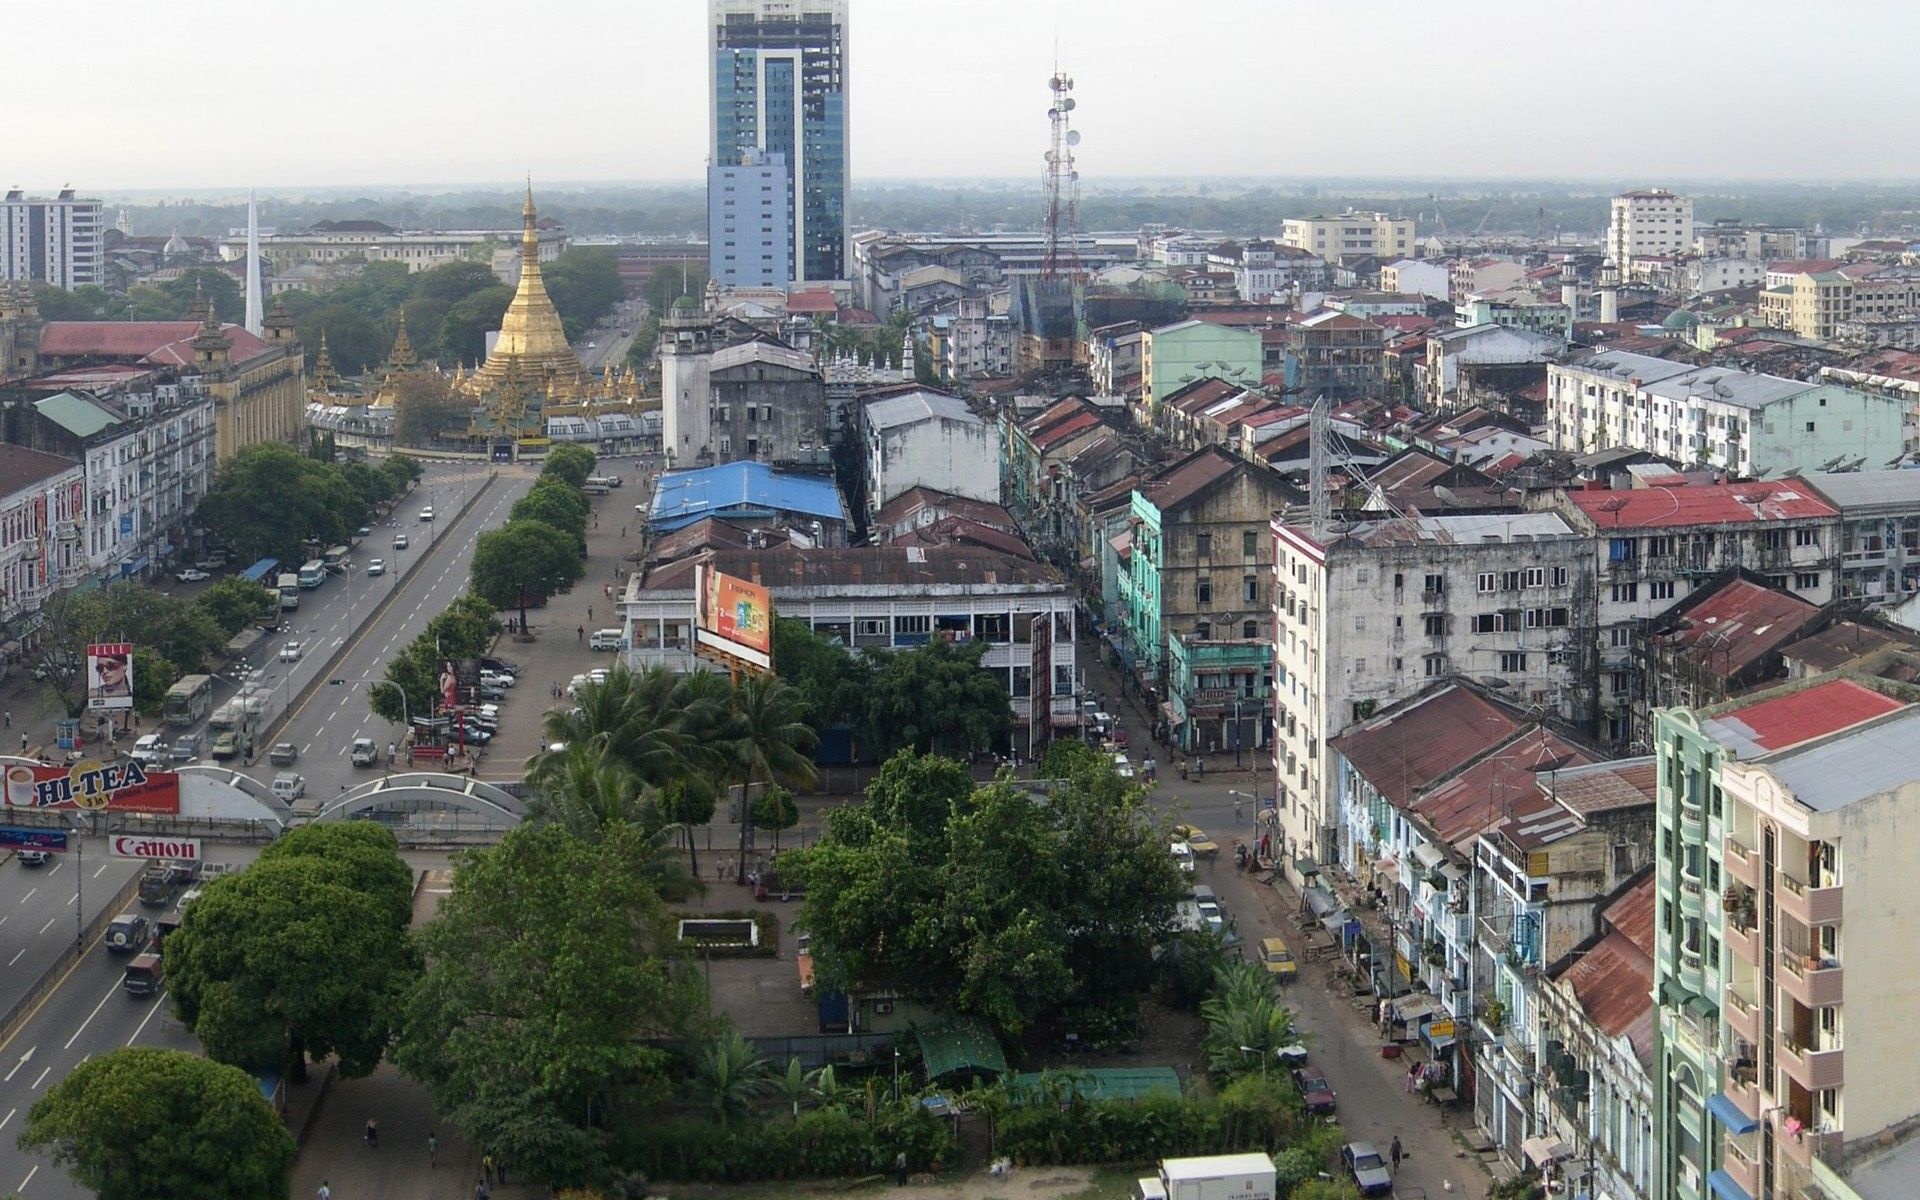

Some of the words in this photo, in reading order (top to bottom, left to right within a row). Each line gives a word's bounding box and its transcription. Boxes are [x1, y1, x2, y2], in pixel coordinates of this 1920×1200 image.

[95, 645, 124, 656] ELLE
[36, 761, 147, 807] HI-TEA
[115, 837, 195, 858] Canon
